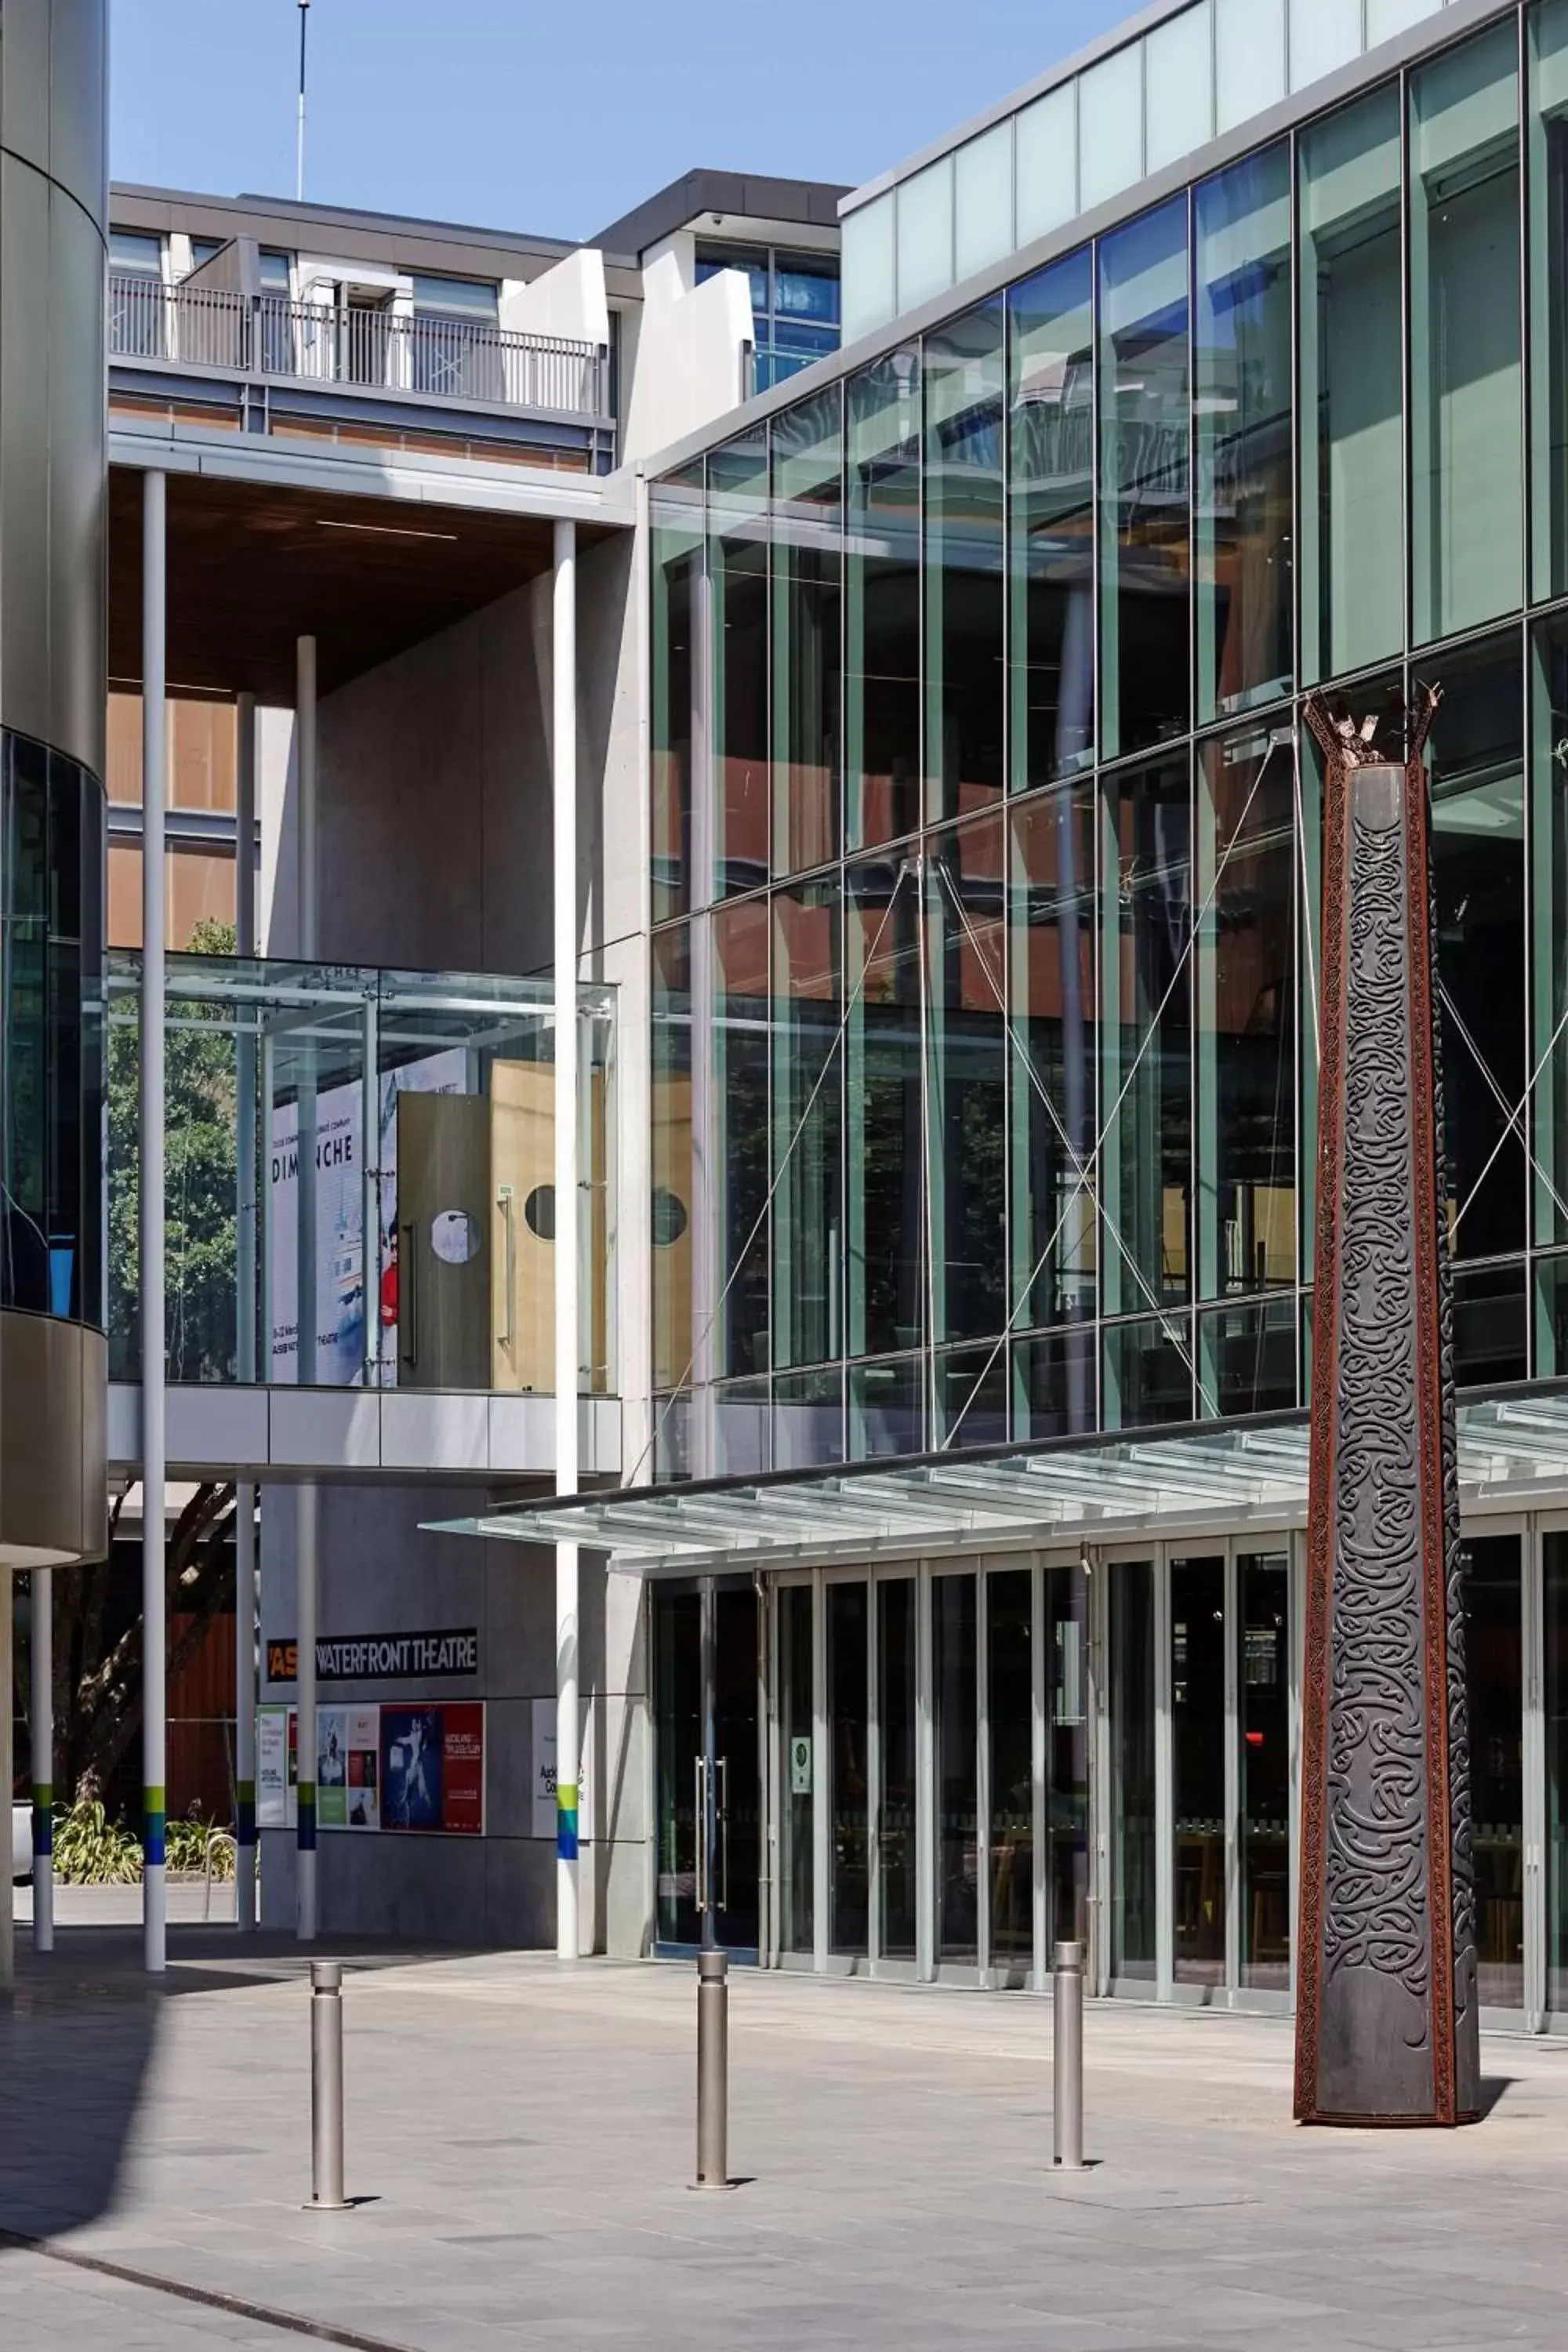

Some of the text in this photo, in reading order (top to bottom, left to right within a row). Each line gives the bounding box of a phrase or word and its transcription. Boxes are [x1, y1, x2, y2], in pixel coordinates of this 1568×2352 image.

[272, 1135, 351, 1184] DIMNCHE
[270, 1635, 477, 1676] AS WATERFRONT THEATRE
